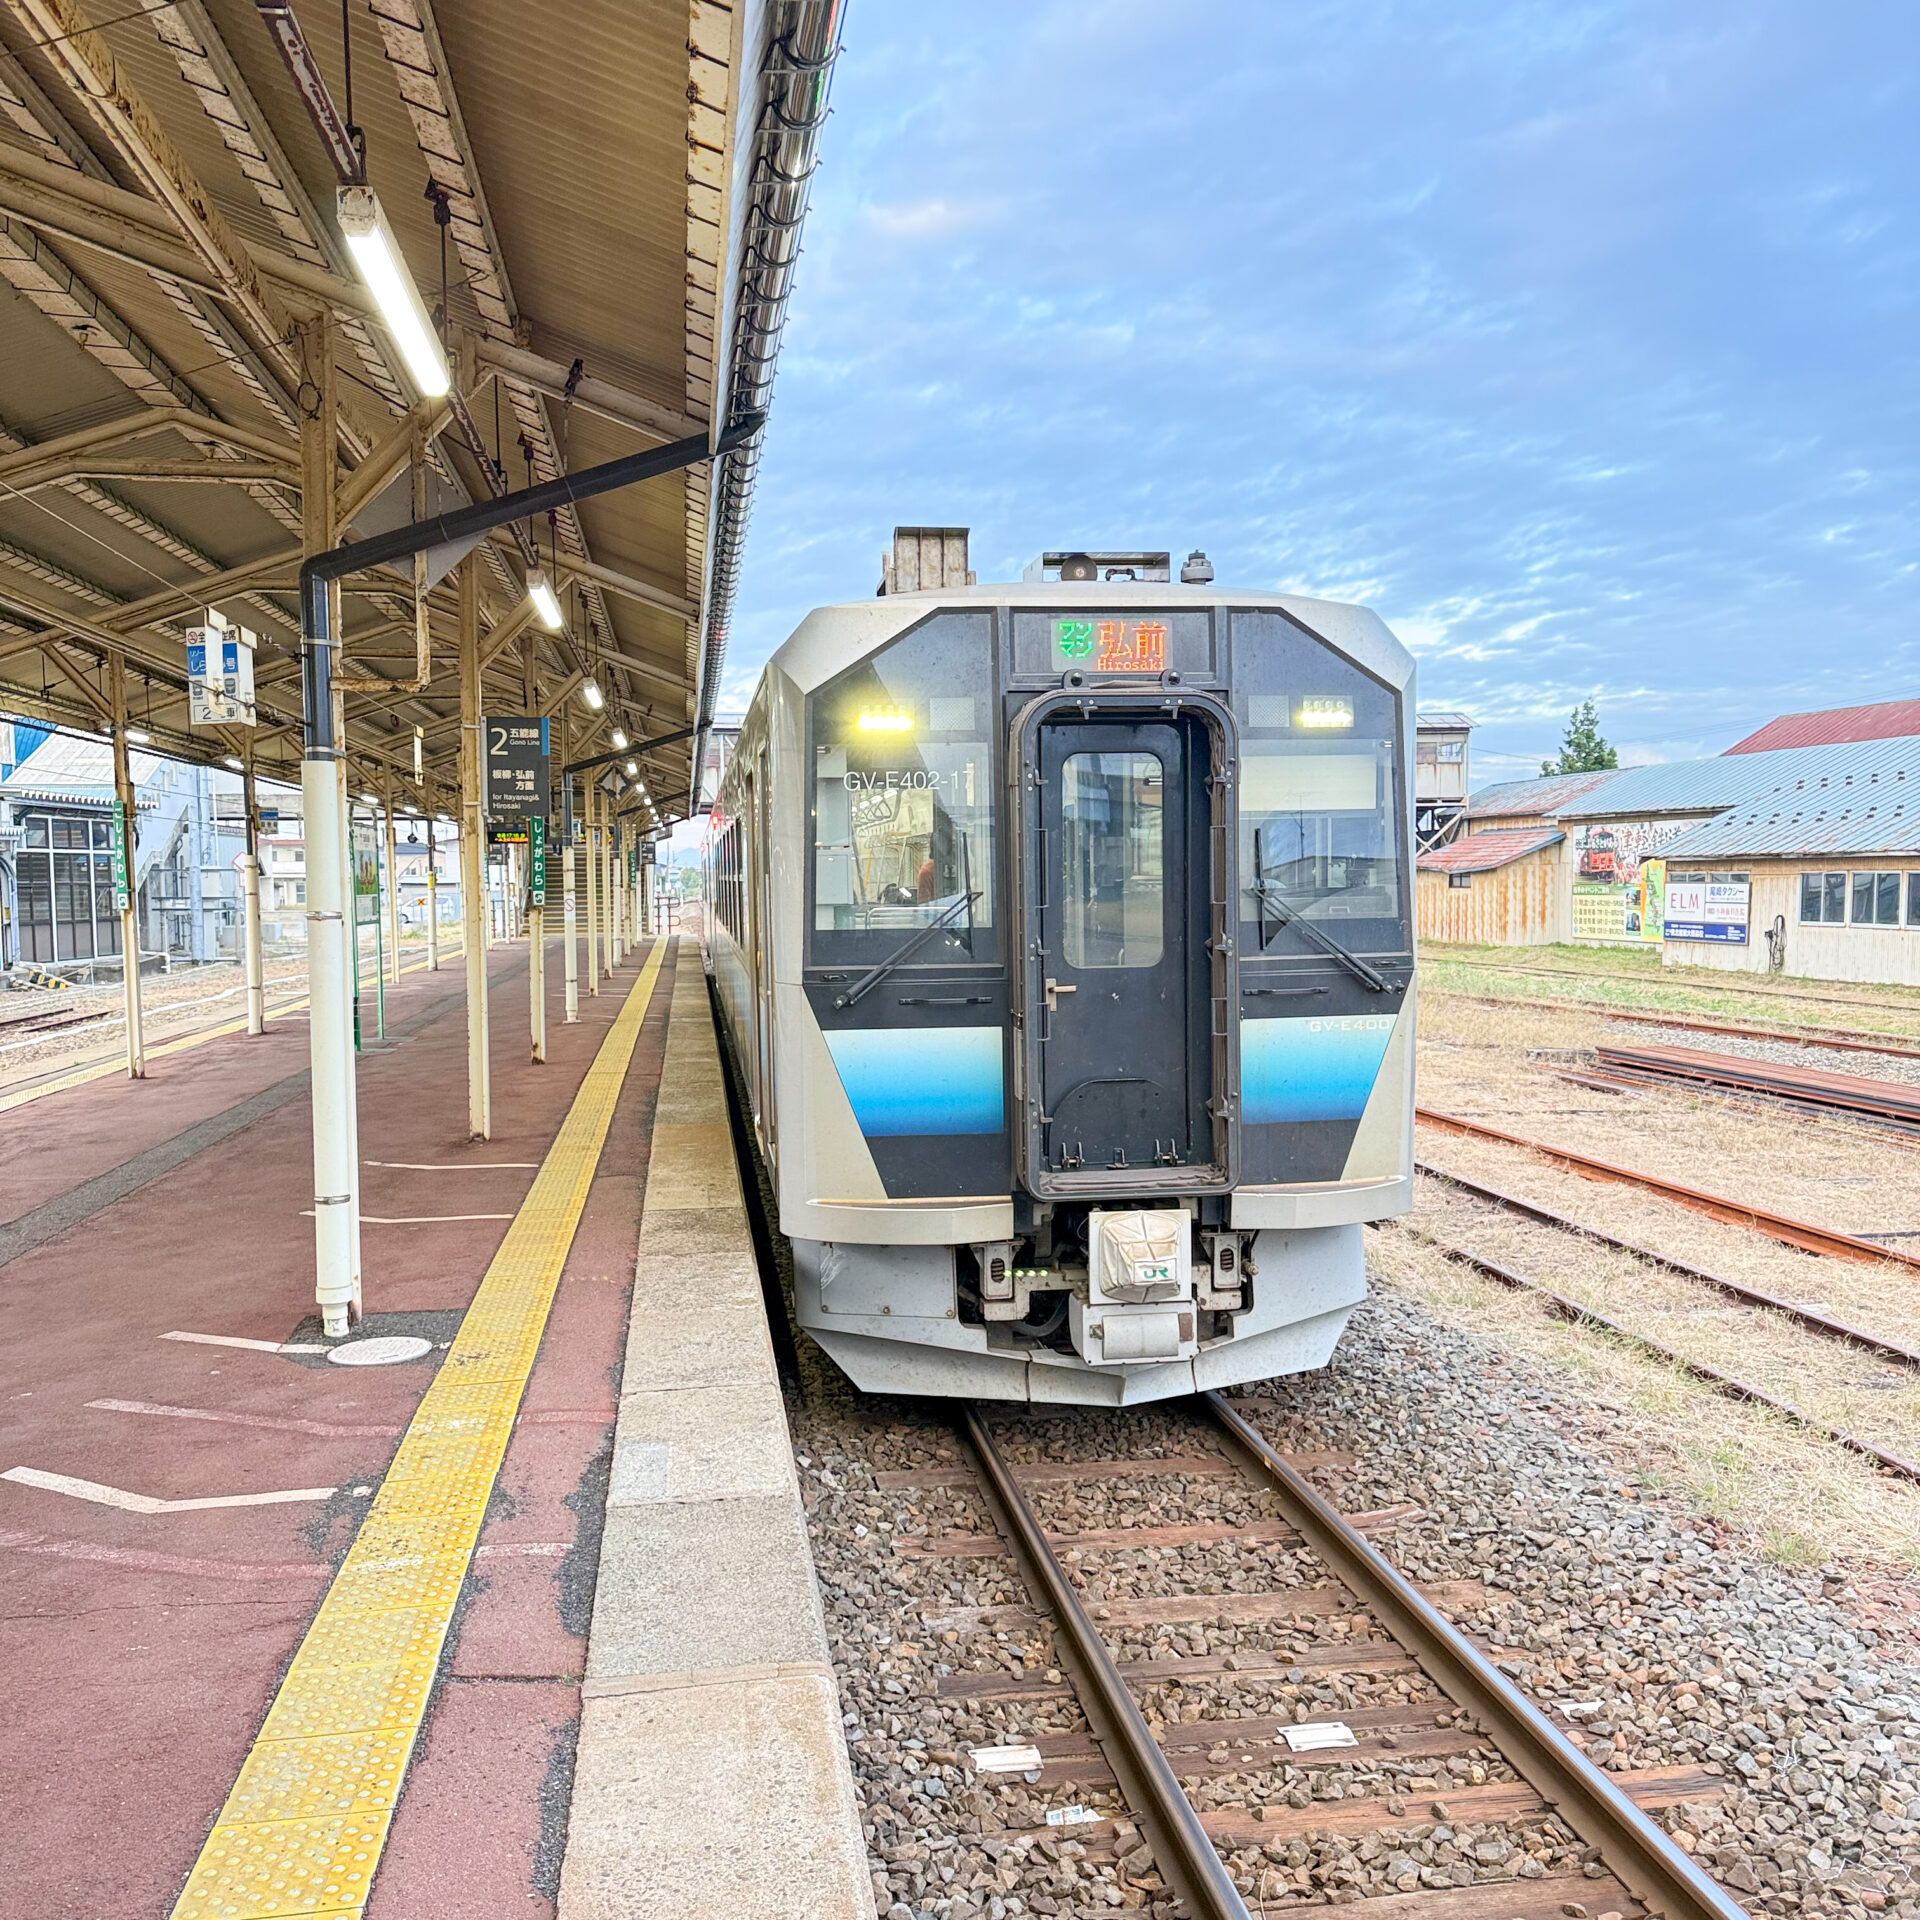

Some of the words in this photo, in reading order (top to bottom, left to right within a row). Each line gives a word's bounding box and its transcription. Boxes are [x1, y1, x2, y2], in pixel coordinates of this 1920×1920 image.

[1096, 620, 1168, 658] 弘前
[190, 657, 236, 672] しら号
[1097, 658, 1164, 671] Hirosaki
[202, 706, 235, 719] 2車
[509, 728, 539, 739] 五能線
[490, 727, 509, 756] 2
[515, 781, 535, 791] 方面
[492, 793, 503, 801] for
[492, 802, 521, 810] Hirosaki
[533, 816, 543, 886] しょがわら
[1670, 892, 1699, 910] ELM
[1309, 1019, 1391, 1033] GV-E400
